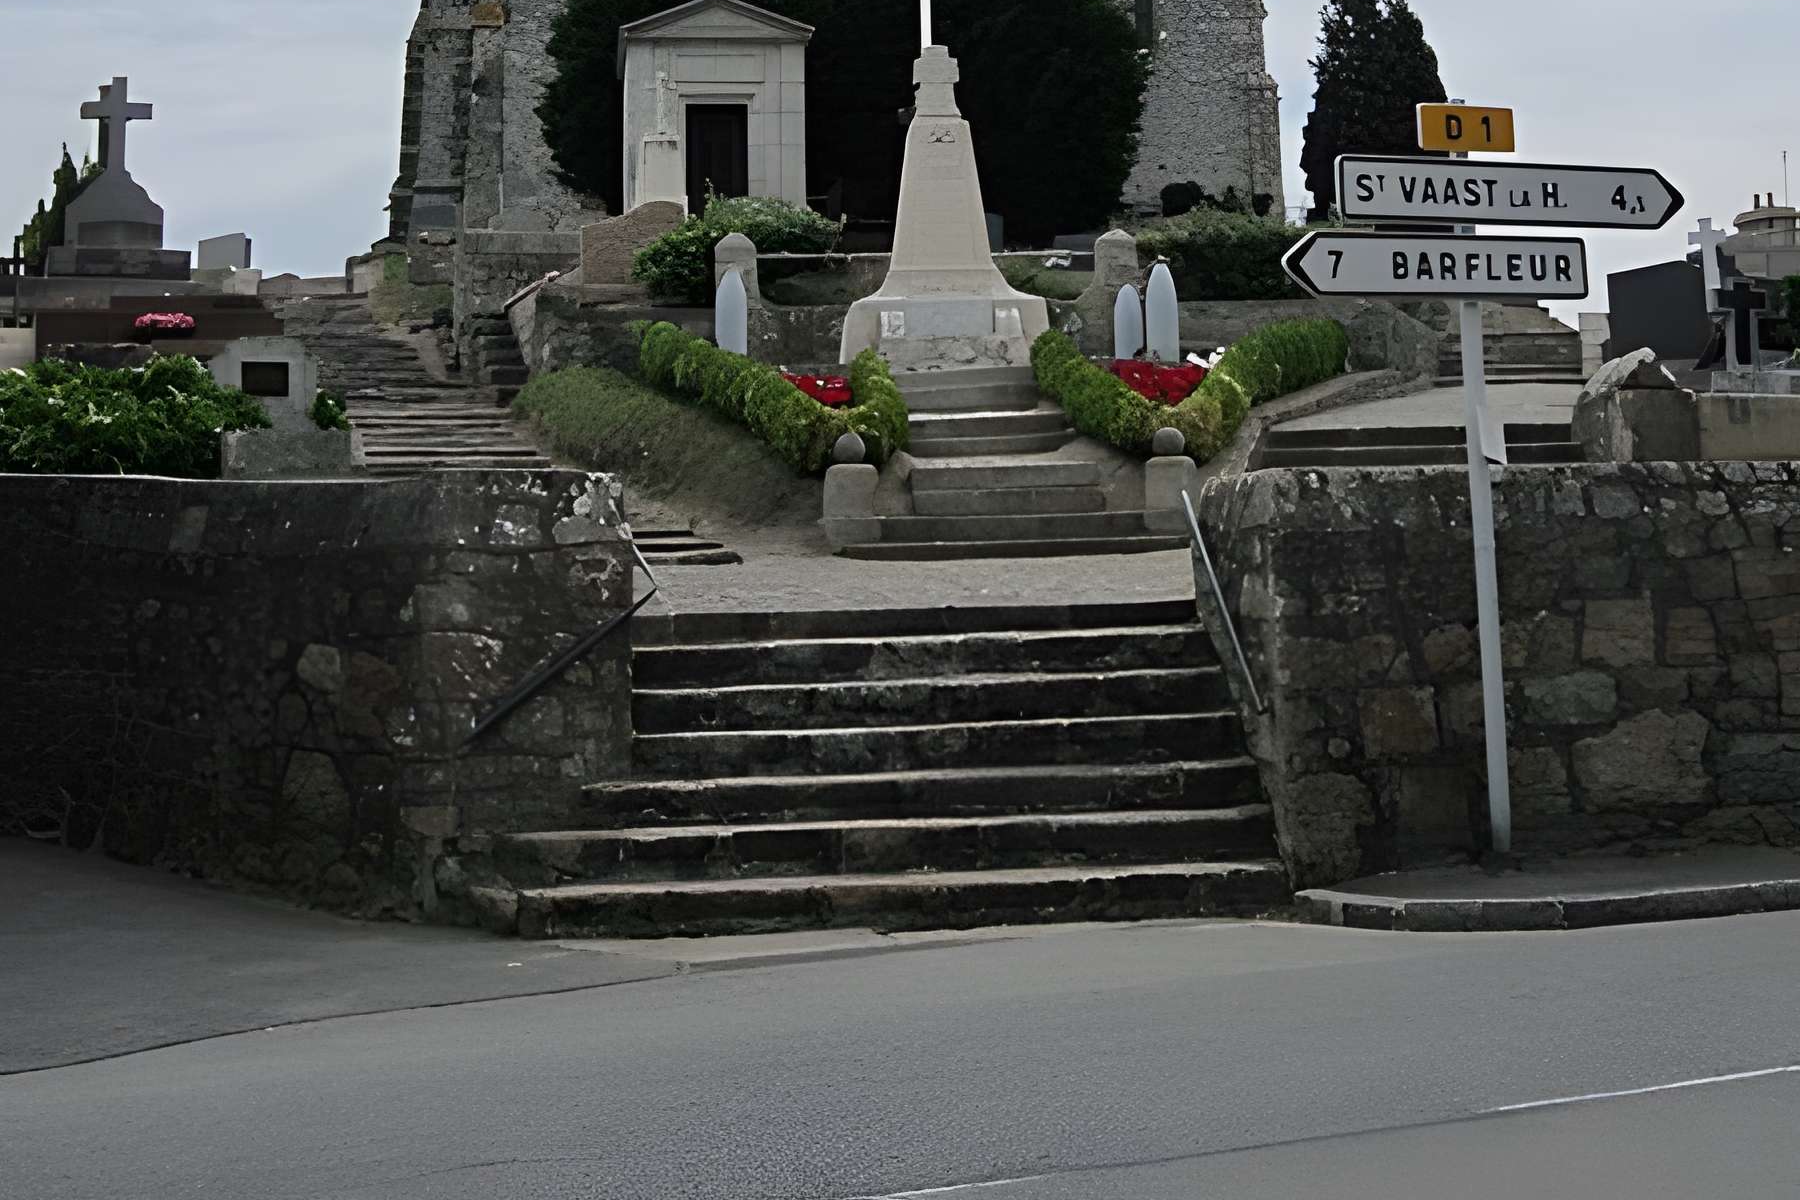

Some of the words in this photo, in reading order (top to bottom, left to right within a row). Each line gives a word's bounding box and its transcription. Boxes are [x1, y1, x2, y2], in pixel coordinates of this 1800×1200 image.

[1445, 114, 1462, 140] D
[1481, 115, 1492, 143] 1
[1398, 175, 1498, 207] VAAST
[1327, 249, 1344, 279] 7
[1392, 251, 1572, 282] BARFLEUR
